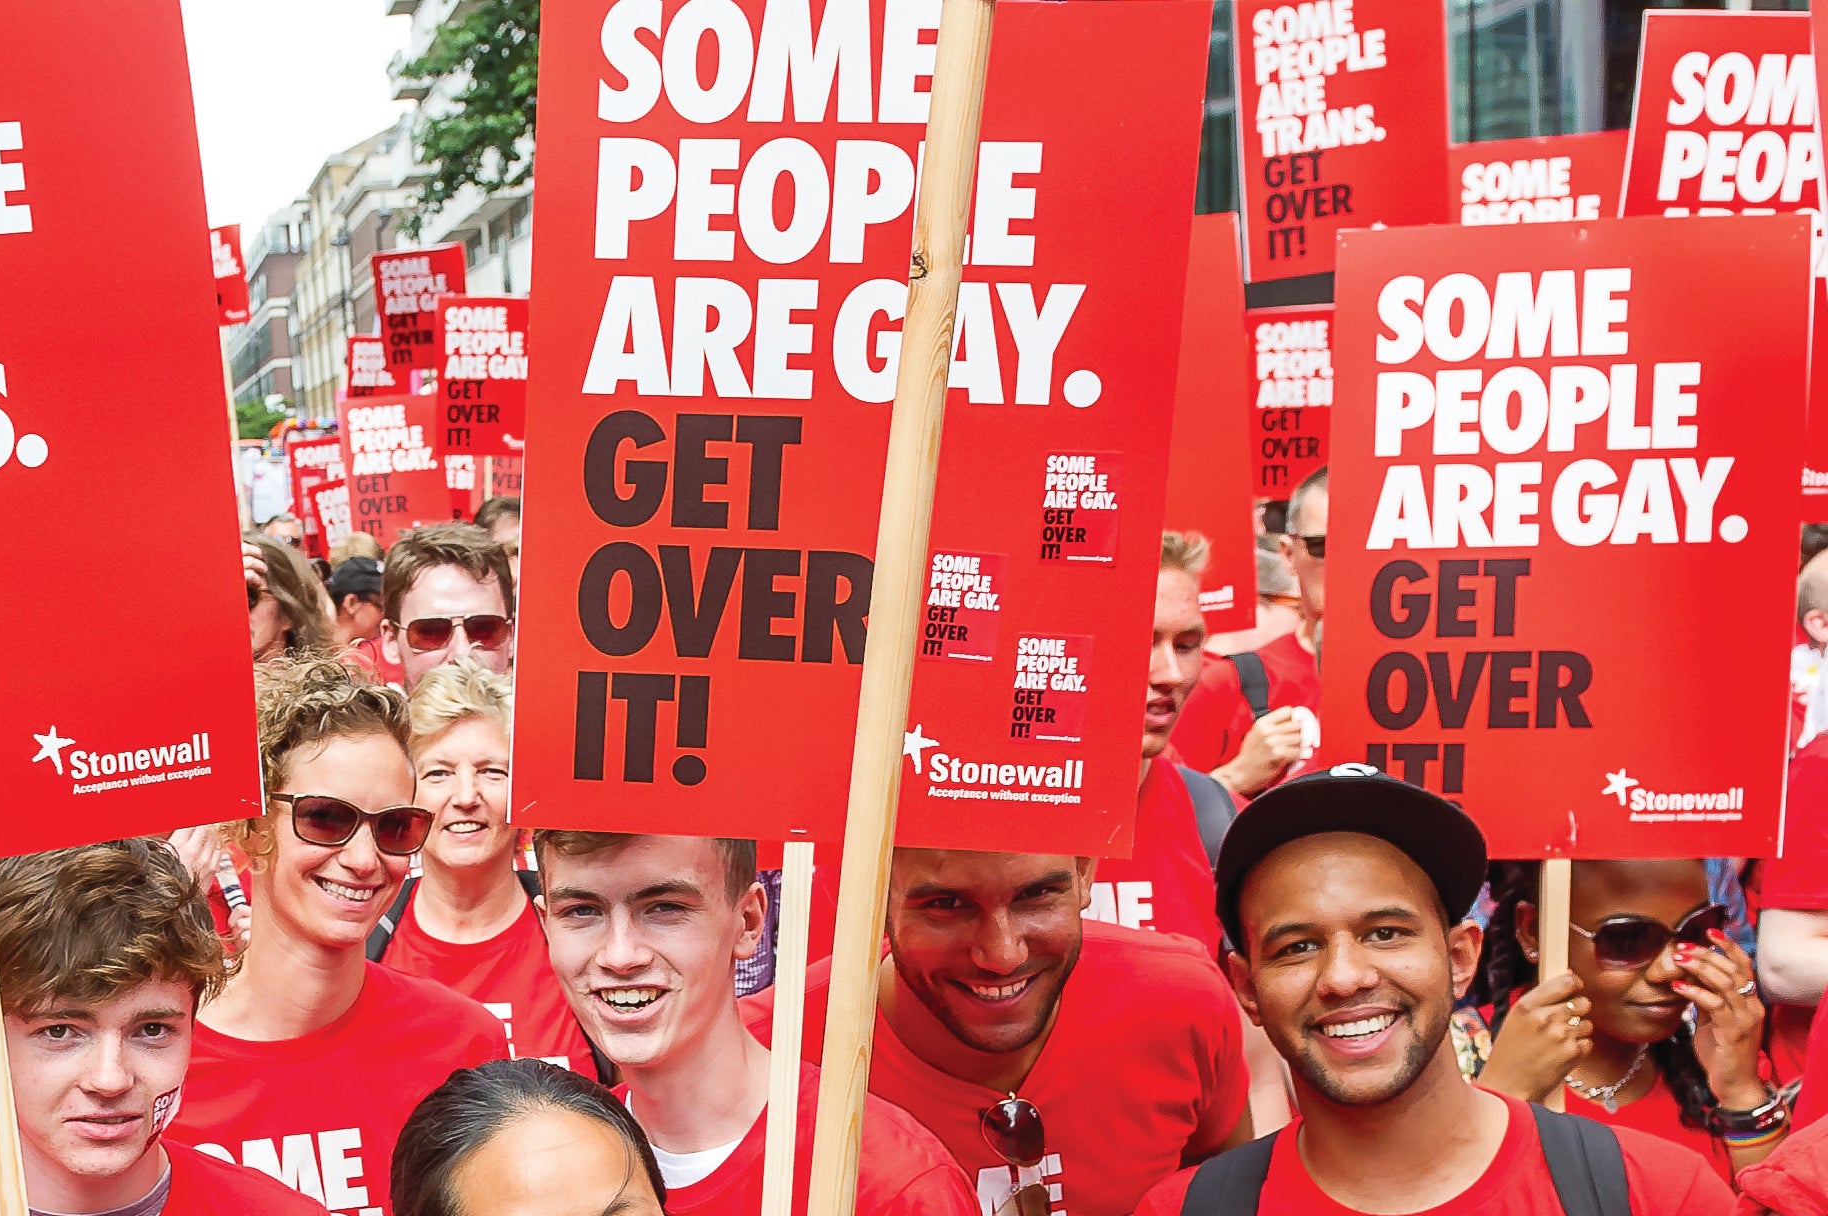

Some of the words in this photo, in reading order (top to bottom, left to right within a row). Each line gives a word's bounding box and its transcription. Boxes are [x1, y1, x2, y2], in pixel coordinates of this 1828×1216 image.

[1252, 0, 1354, 48] SOME
[597, 0, 939, 125] SOME
[1255, 28, 1387, 85] PEOPLE
[1256, 75, 1326, 121] ARE
[1256, 104, 1387, 157] TRANS.
[1265, 151, 1322, 188] GET
[1461, 156, 1571, 204] SOME
[593, 137, 1044, 267] PEOPE
[1266, 184, 1353, 224] OVER
[1268, 226, 1306, 260] IT!
[444, 306, 508, 332] SOME
[1375, 267, 1631, 364] SOME
[445, 331, 524, 356] PEOPLE
[581, 275, 818, 400] ARE
[833, 279, 1102, 408] GAY.
[1255, 320, 1328, 353] SOME
[444, 355, 487, 380] ARE
[448, 379, 484, 399] GET
[1256, 378, 1307, 408] ARE
[347, 404, 405, 427] SOME
[448, 404, 501, 424] OVER
[1261, 408, 1302, 432] GET
[1375, 361, 1701, 457] PEOPLE
[349, 424, 423, 453] PEOPLE
[448, 428, 471, 447] IT!
[1261, 436, 1320, 459] OVER
[352, 451, 393, 476] ARE
[393, 446, 438, 474] GAY.
[584, 410, 802, 532] GET
[1046, 455, 1095, 474] SOME
[357, 474, 390, 494] GET
[1045, 473, 1108, 491] PEOPLE
[1262, 464, 1288, 486] IT!
[359, 495, 409, 516] OVER
[1043, 490, 1077, 508] ARE
[1080, 491, 1117, 510] GAY.
[1366, 461, 1539, 550] ARE
[1551, 457, 1748, 547] GAY.
[1044, 509, 1074, 525] GET
[1042, 526, 1086, 542] OVER
[932, 554, 980, 574] SOME
[1041, 544, 1060, 559] IT!
[930, 572, 991, 592] PEOPLE
[577, 541, 877, 666] OVER
[927, 589, 960, 608] ARE
[964, 592, 1000, 611] GAY.
[1370, 558, 1530, 639] GET
[927, 606, 958, 623] GET
[925, 623, 967, 641] OVER
[923, 640, 942, 656] IT!
[1017, 637, 1066, 657] SOME
[1016, 655, 1078, 674] PEOPLE
[1013, 672, 1047, 691] ARE
[1050, 674, 1086, 692] GAY.
[1366, 650, 1593, 729] OVER
[1013, 689, 1044, 705] GET
[1012, 706, 1055, 724] OVER
[574, 670, 708, 788] IT!
[1011, 723, 1030, 738] IT!
[70, 732, 210, 779] Stonewall
[73, 778, 129, 795] Acceptance
[130, 772, 165, 786] without
[167, 765, 211, 780] exception
[929, 753, 1083, 788] Stonewall
[928, 785, 987, 800] Acceptance
[990, 789, 1029, 802] without
[1031, 791, 1081, 805] exception
[1630, 787, 1744, 812] Stonewall
